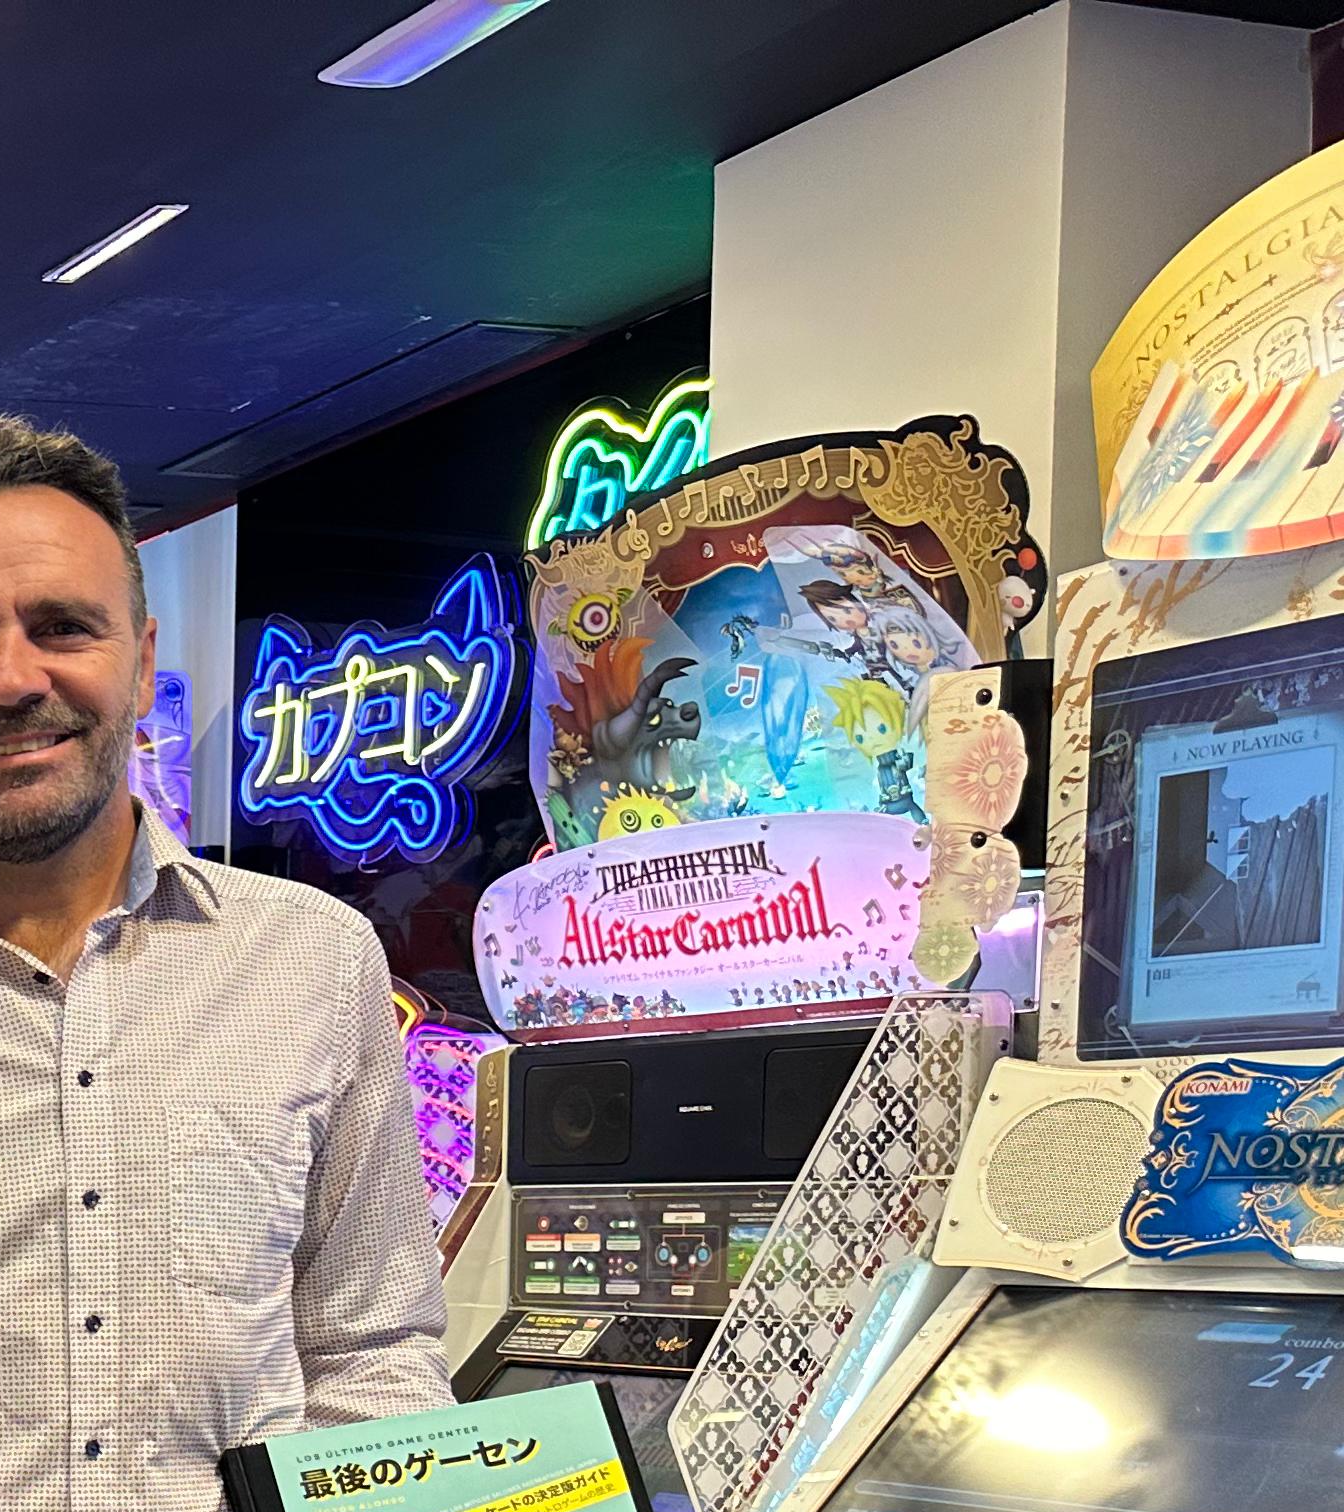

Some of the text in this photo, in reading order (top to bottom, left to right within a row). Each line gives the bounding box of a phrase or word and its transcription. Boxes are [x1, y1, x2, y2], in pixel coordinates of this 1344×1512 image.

[1134, 205, 1344, 374] NOSTALGIA
[253, 654, 487, 788] カプコン
[1186, 730, 1304, 761] NOW PLAYING
[637, 887, 674, 911] FINAL
[1185, 1081, 1250, 1095] KONAMI
[1284, 1336, 1344, 1350] combo
[1248, 1352, 1334, 1390] 24
[296, 1452, 321, 1464] LOS
[325, 1440, 383, 1459] ÚLTIMOS
[387, 1434, 424, 1448] GAME
[299, 1436, 540, 1502] 最後のゲーセン
